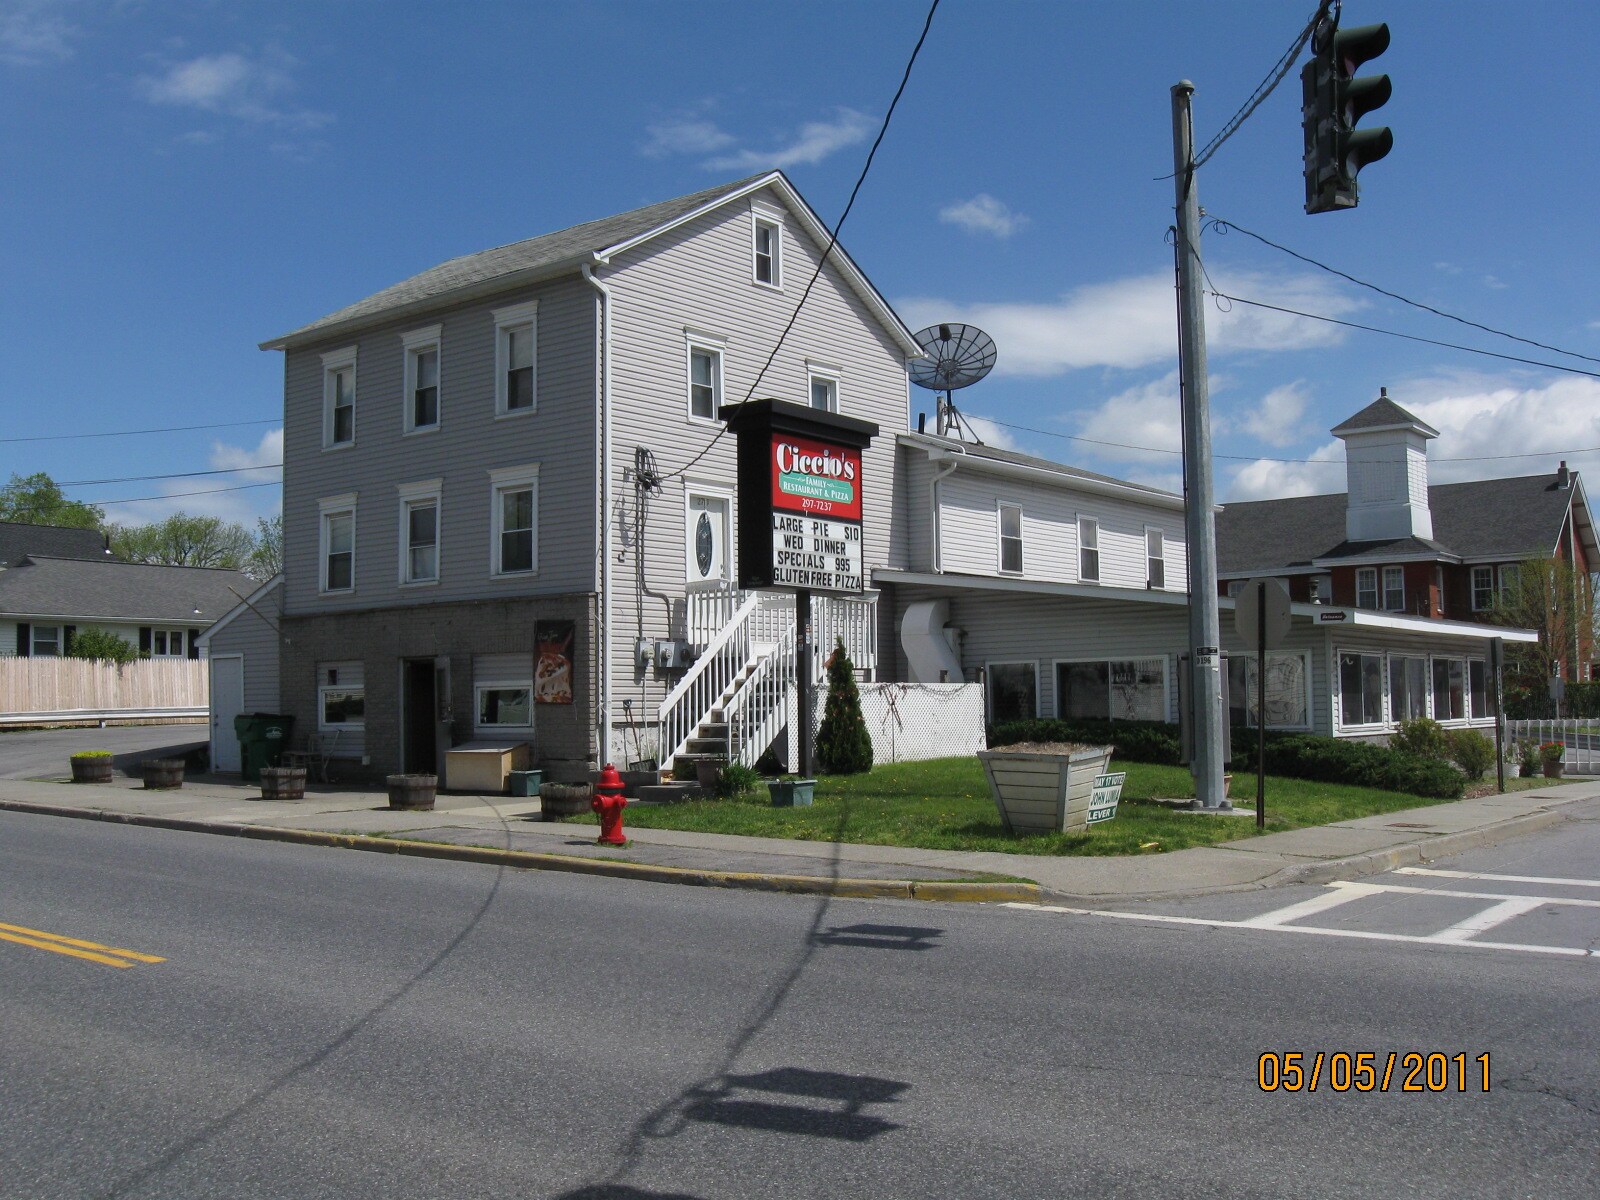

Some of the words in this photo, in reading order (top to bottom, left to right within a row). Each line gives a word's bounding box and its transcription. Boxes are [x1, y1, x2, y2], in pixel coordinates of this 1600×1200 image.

[776, 442, 854, 480] Ciccio's
[783, 481, 823, 497] RESTAURANT
[823, 489, 829, 498] &
[831, 490, 849, 501] PIZZA
[806, 476, 827, 488] FAMILY
[802, 498, 832, 512] 297-7237
[773, 515, 804, 534] LARGE
[813, 521, 829, 537] PIE
[783, 534, 803, 550] WED
[814, 538, 846, 556] DINNER
[777, 550, 825, 570] SPECIALS
[835, 557, 850, 572] 995
[773, 567, 810, 585] GLUTEN
[810, 571, 833, 587] FREE
[835, 574, 861, 590] PIZZA
[1088, 808, 1110, 820] LEVER
